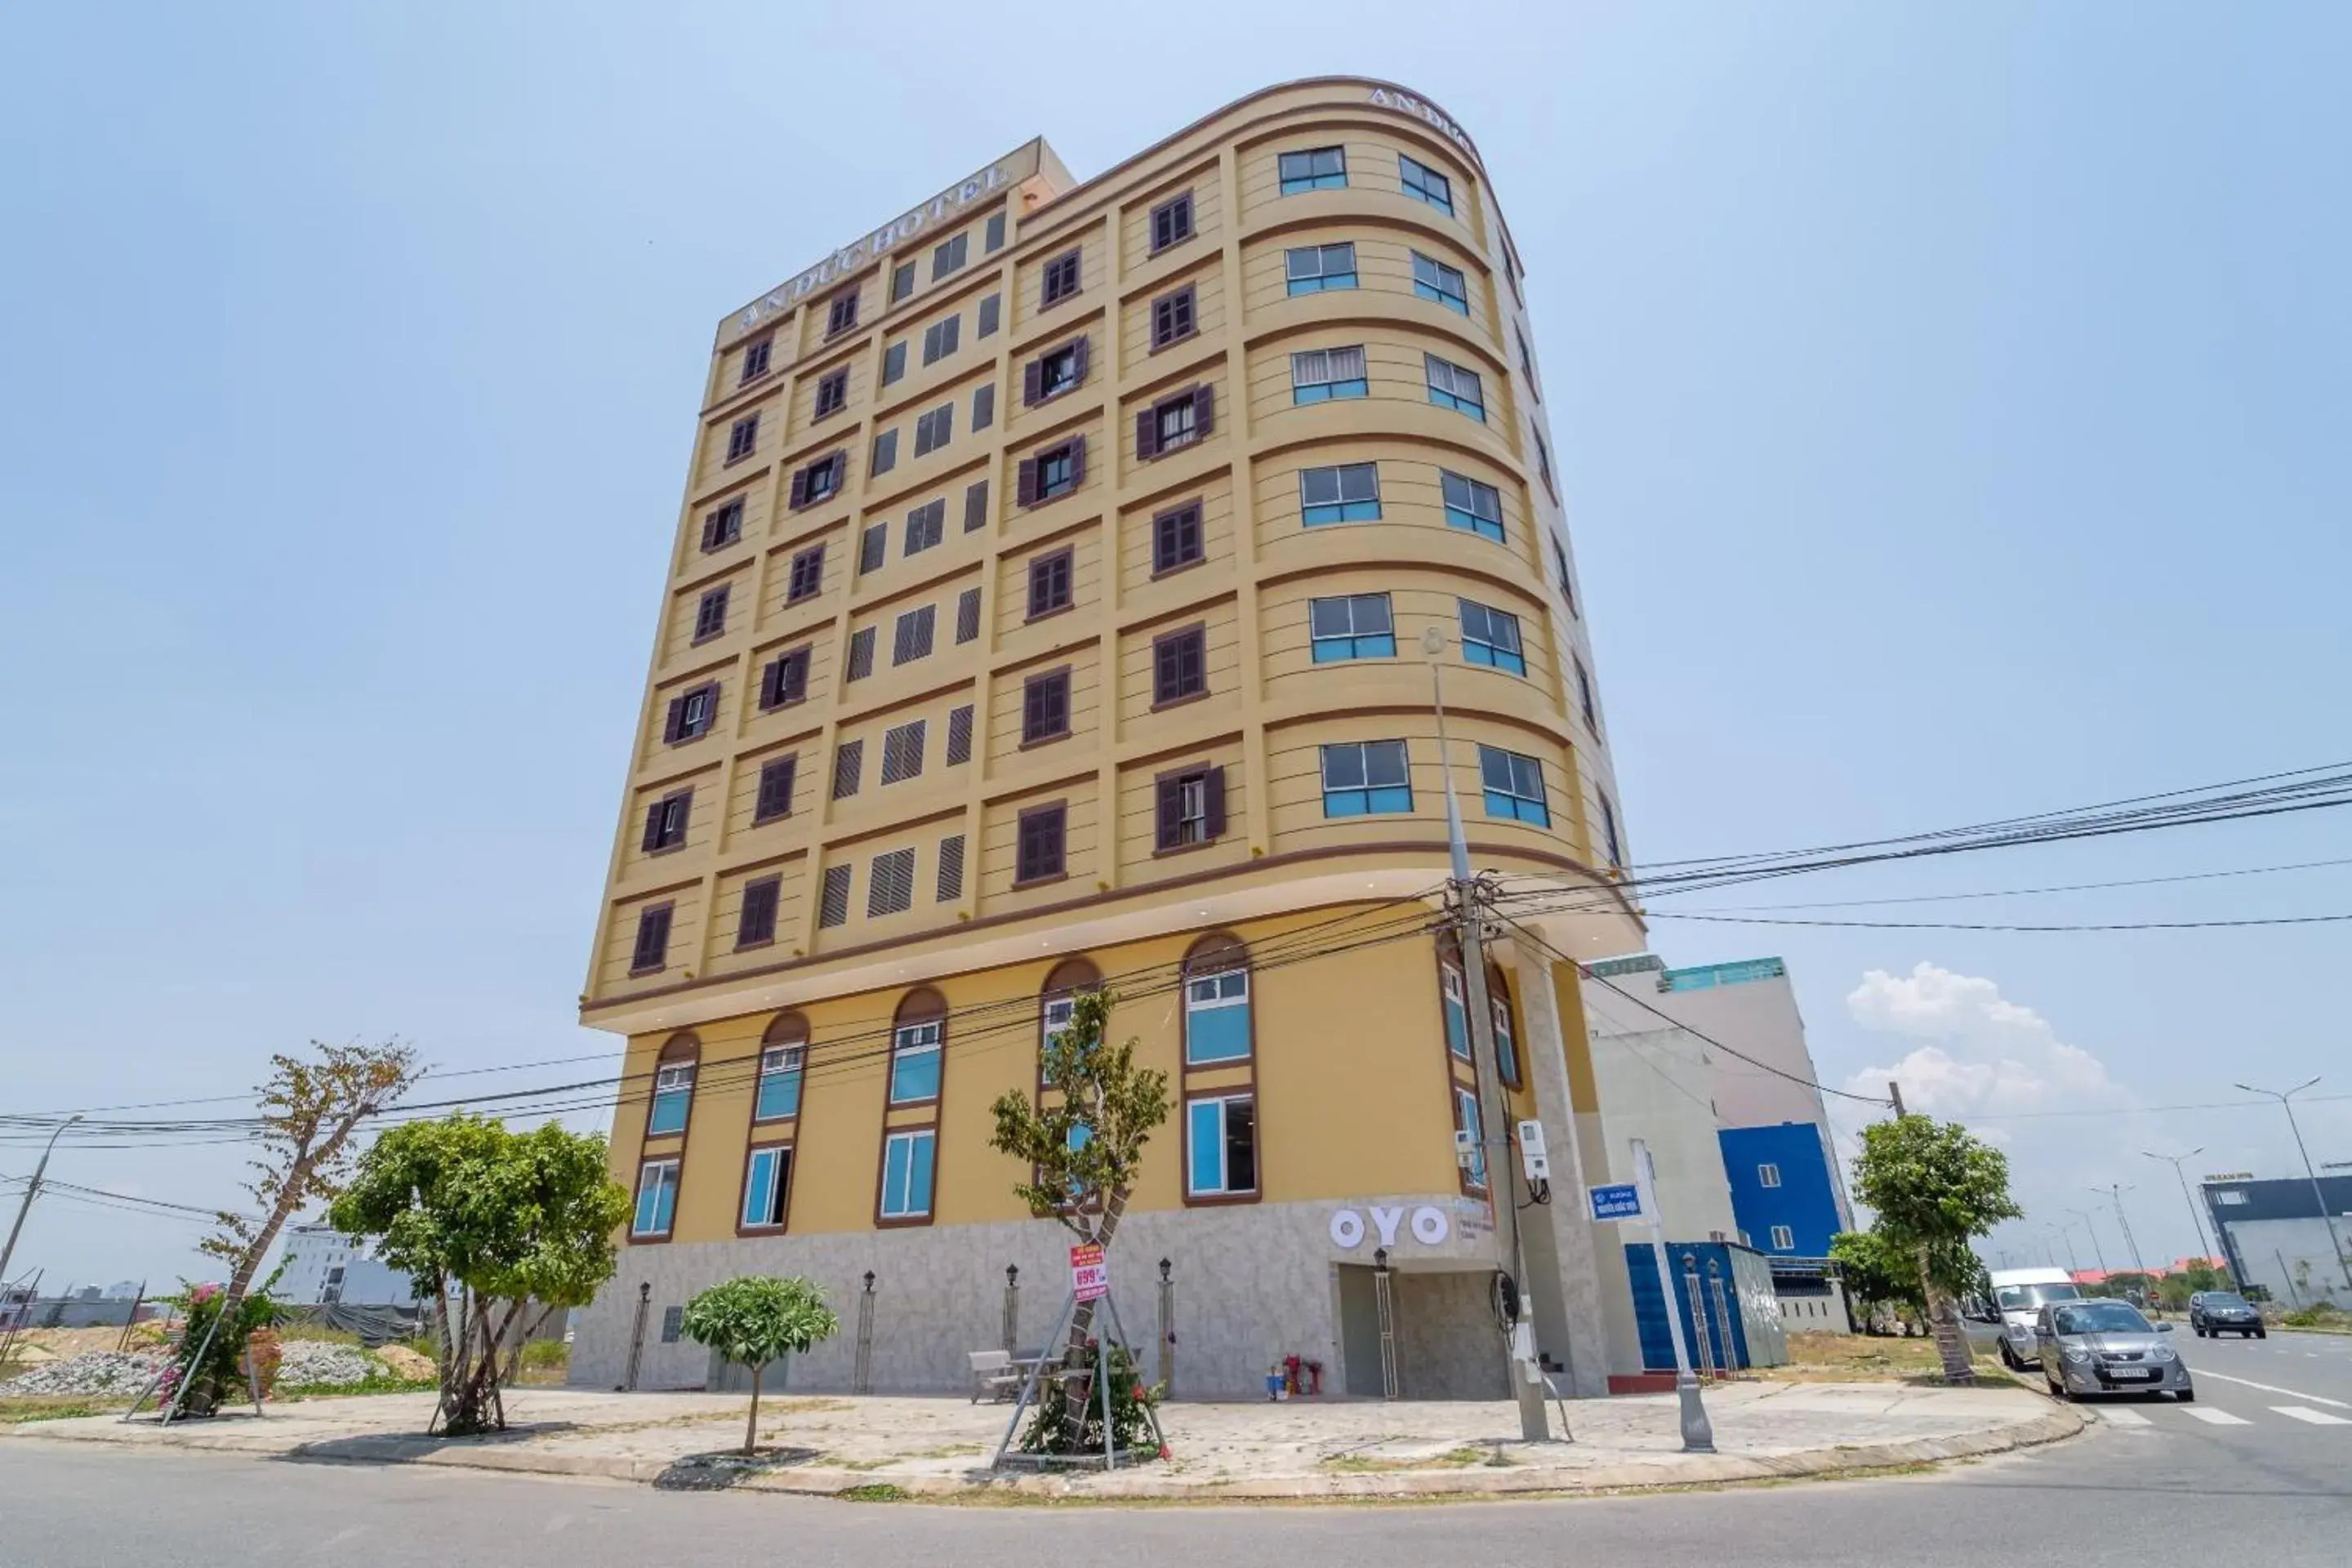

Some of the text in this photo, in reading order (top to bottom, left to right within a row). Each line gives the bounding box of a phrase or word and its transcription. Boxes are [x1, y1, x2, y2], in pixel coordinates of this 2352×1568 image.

[1370, 87, 1417, 114] AN
[871, 163, 1012, 256] HOTEL
[1329, 1206, 1449, 1248] OYO
